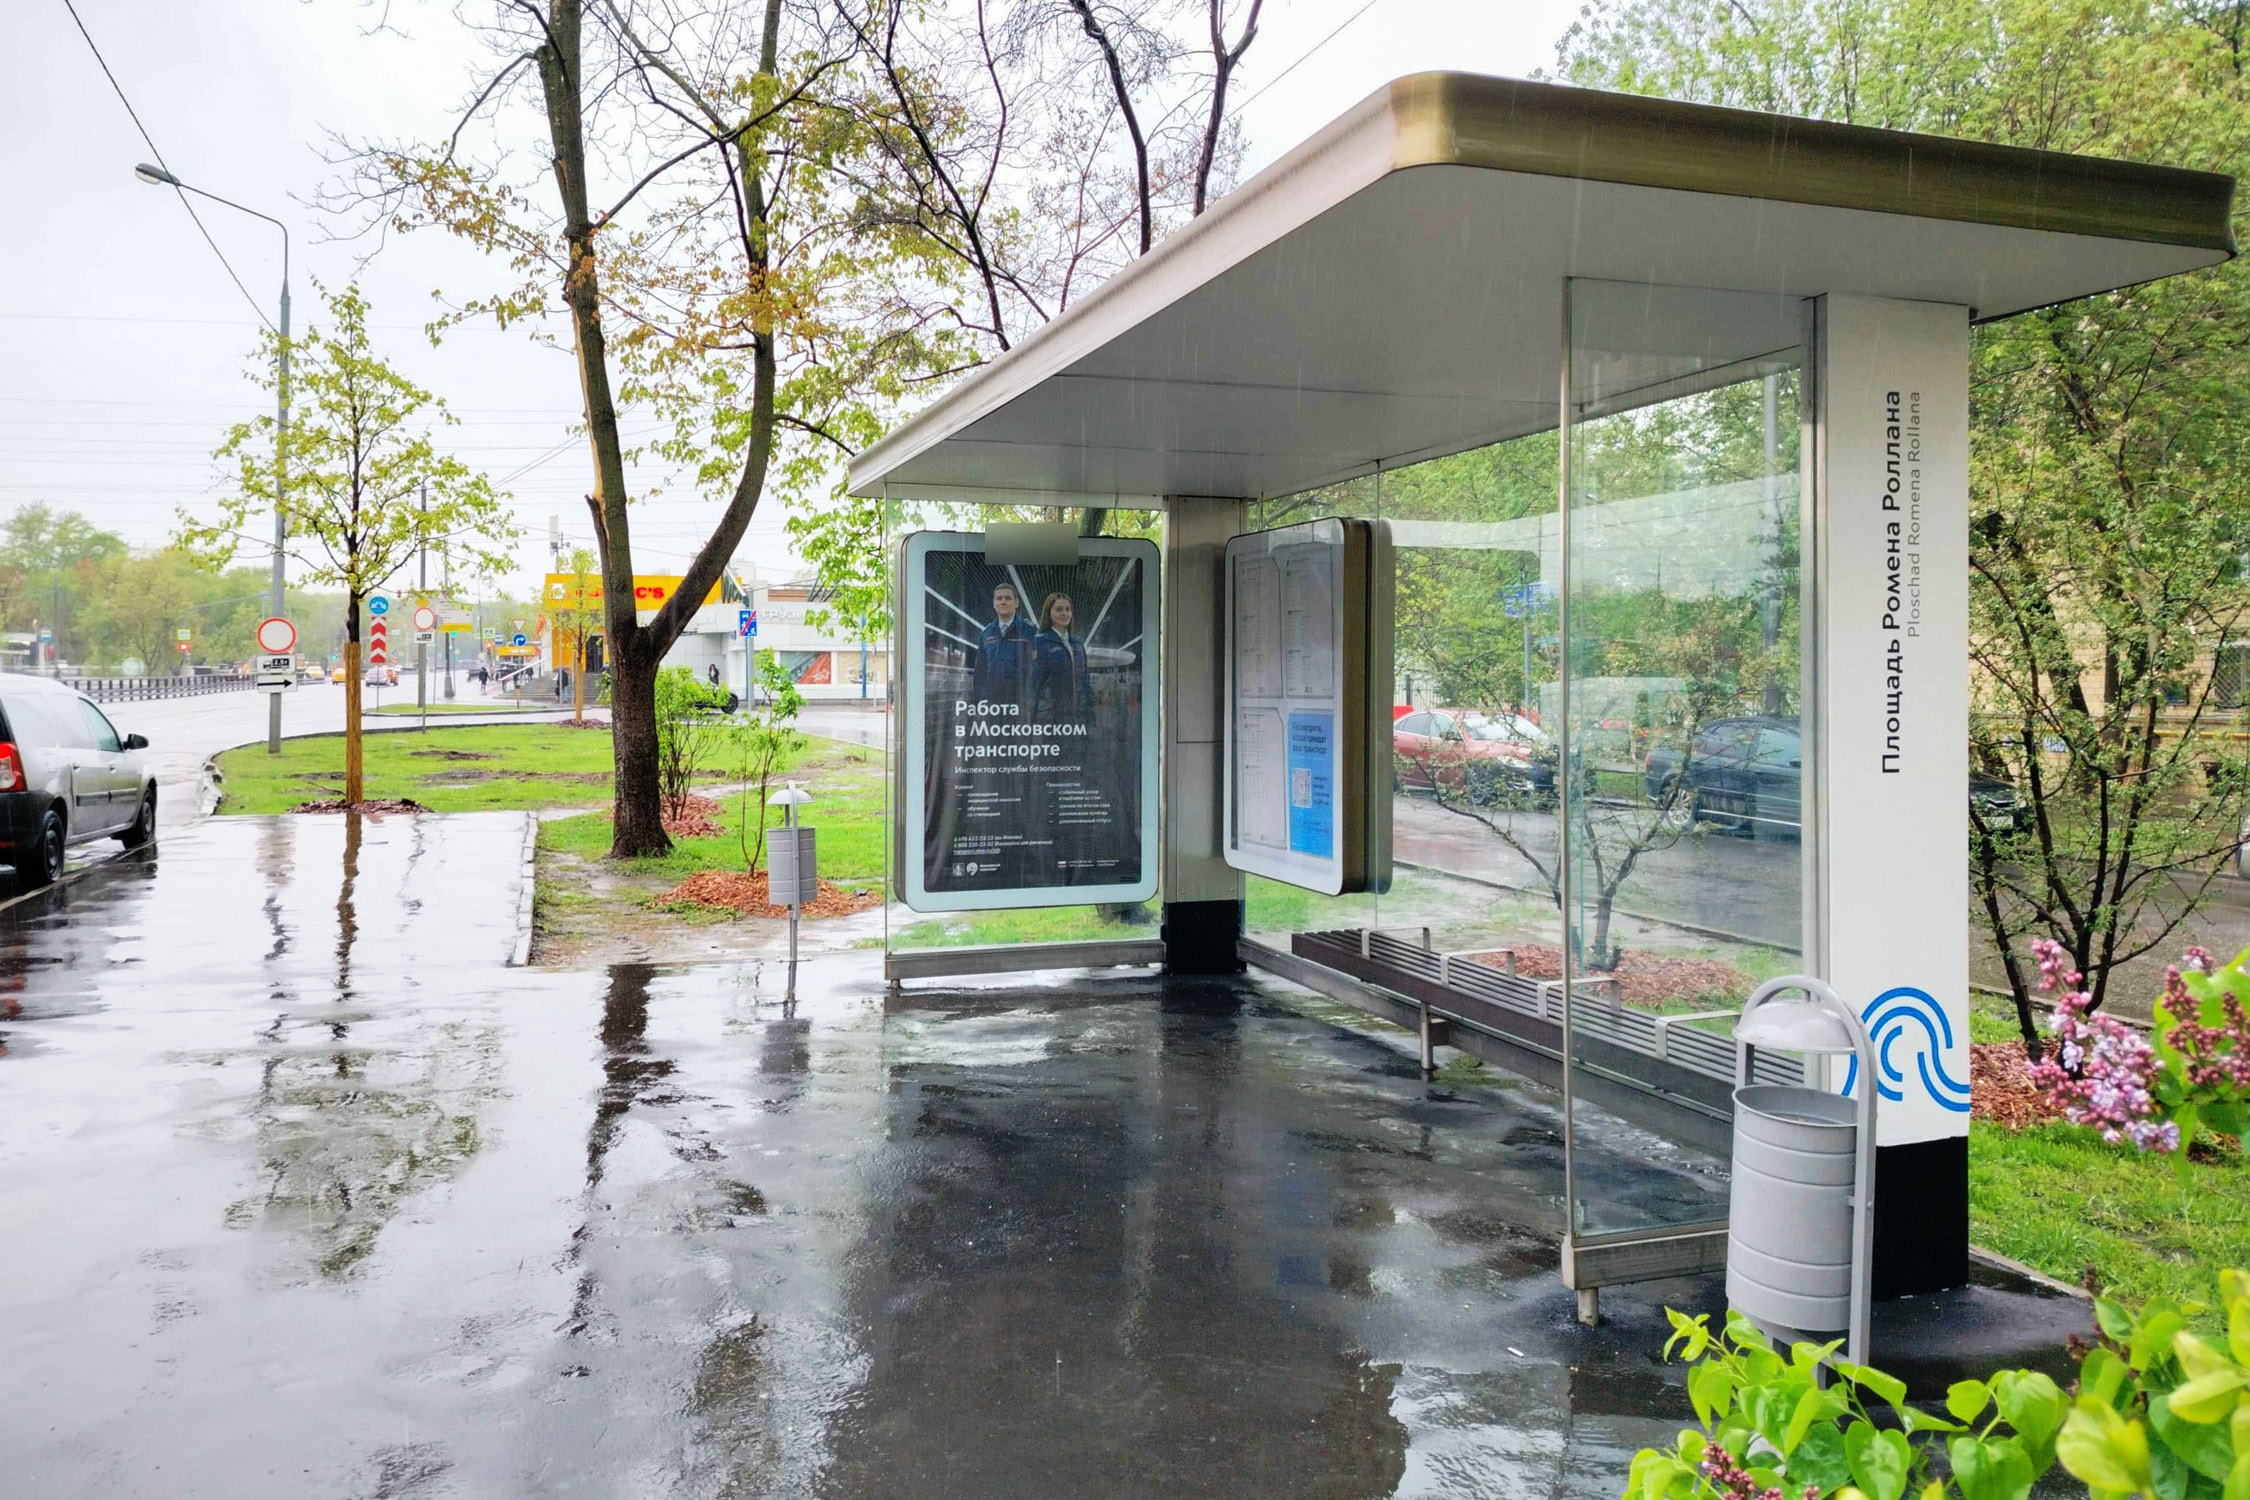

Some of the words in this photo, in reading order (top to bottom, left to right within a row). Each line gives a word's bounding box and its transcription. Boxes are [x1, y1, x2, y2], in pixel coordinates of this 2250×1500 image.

[1882, 391, 1901, 511] Роллана
[1907, 391, 1921, 462] Rollana
[1907, 468, 1921, 546] Romena
[1882, 521, 1902, 630] Ромена
[1907, 553, 1921, 638] Ploschad
[955, 699, 1019, 716] Работа
[955, 725, 966, 737] в
[969, 720, 1087, 737] Московском
[1882, 639, 1904, 774] Площадь
[954, 744, 1060, 761] транспорте
[954, 766, 997, 775] Инспектор
[998, 765, 1028, 775] службы
[1029, 764, 1081, 773] безопасности
